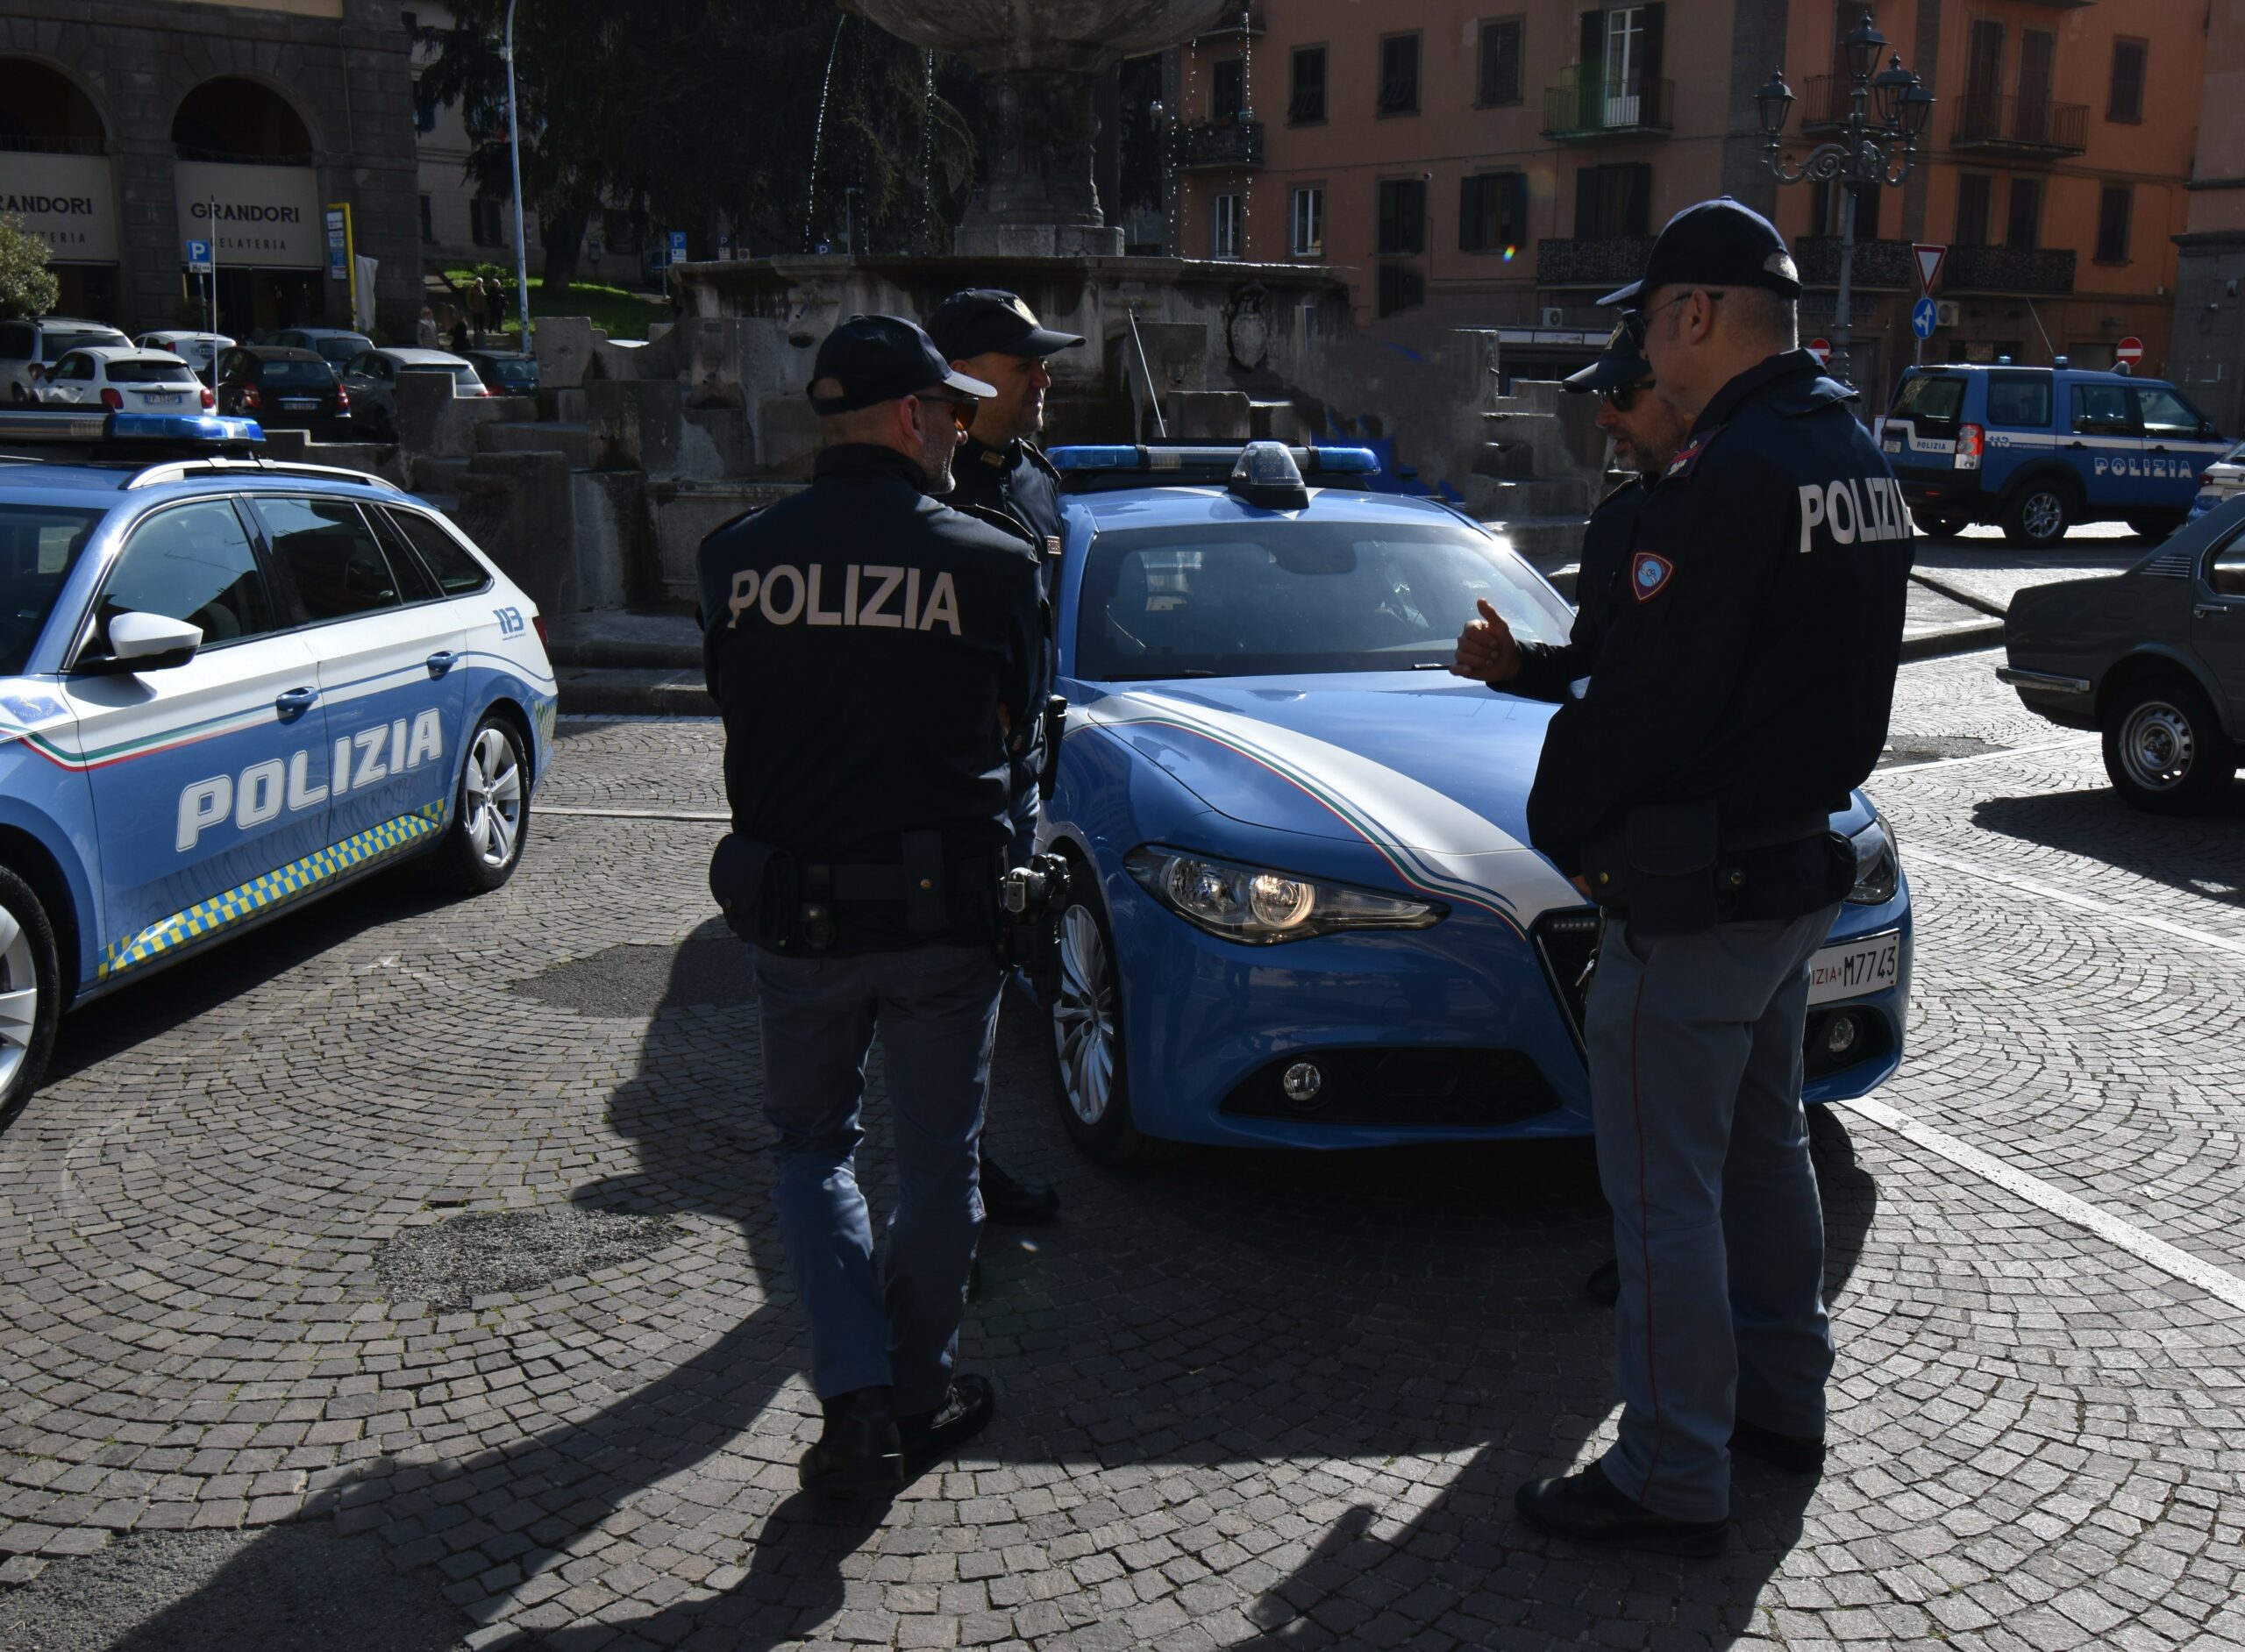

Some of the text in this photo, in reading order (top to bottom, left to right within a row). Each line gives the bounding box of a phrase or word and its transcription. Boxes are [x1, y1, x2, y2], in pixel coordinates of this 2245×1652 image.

[0, 195, 92, 215] ANDORI
[191, 203, 300, 223] GRANDORI
[674, 234, 684, 246] P
[191, 243, 205, 260] P
[1916, 441, 1947, 450] POLIZIA
[1988, 436, 2011, 448] 113
[2094, 457, 2193, 479] POLIZIA
[1799, 477, 1914, 553] POLIZIA
[727, 563, 962, 636] POLIZIA
[492, 607, 524, 635] 113
[175, 708, 442, 853] POLIZIA
[1812, 946, 1896, 987] IZIA M7743
